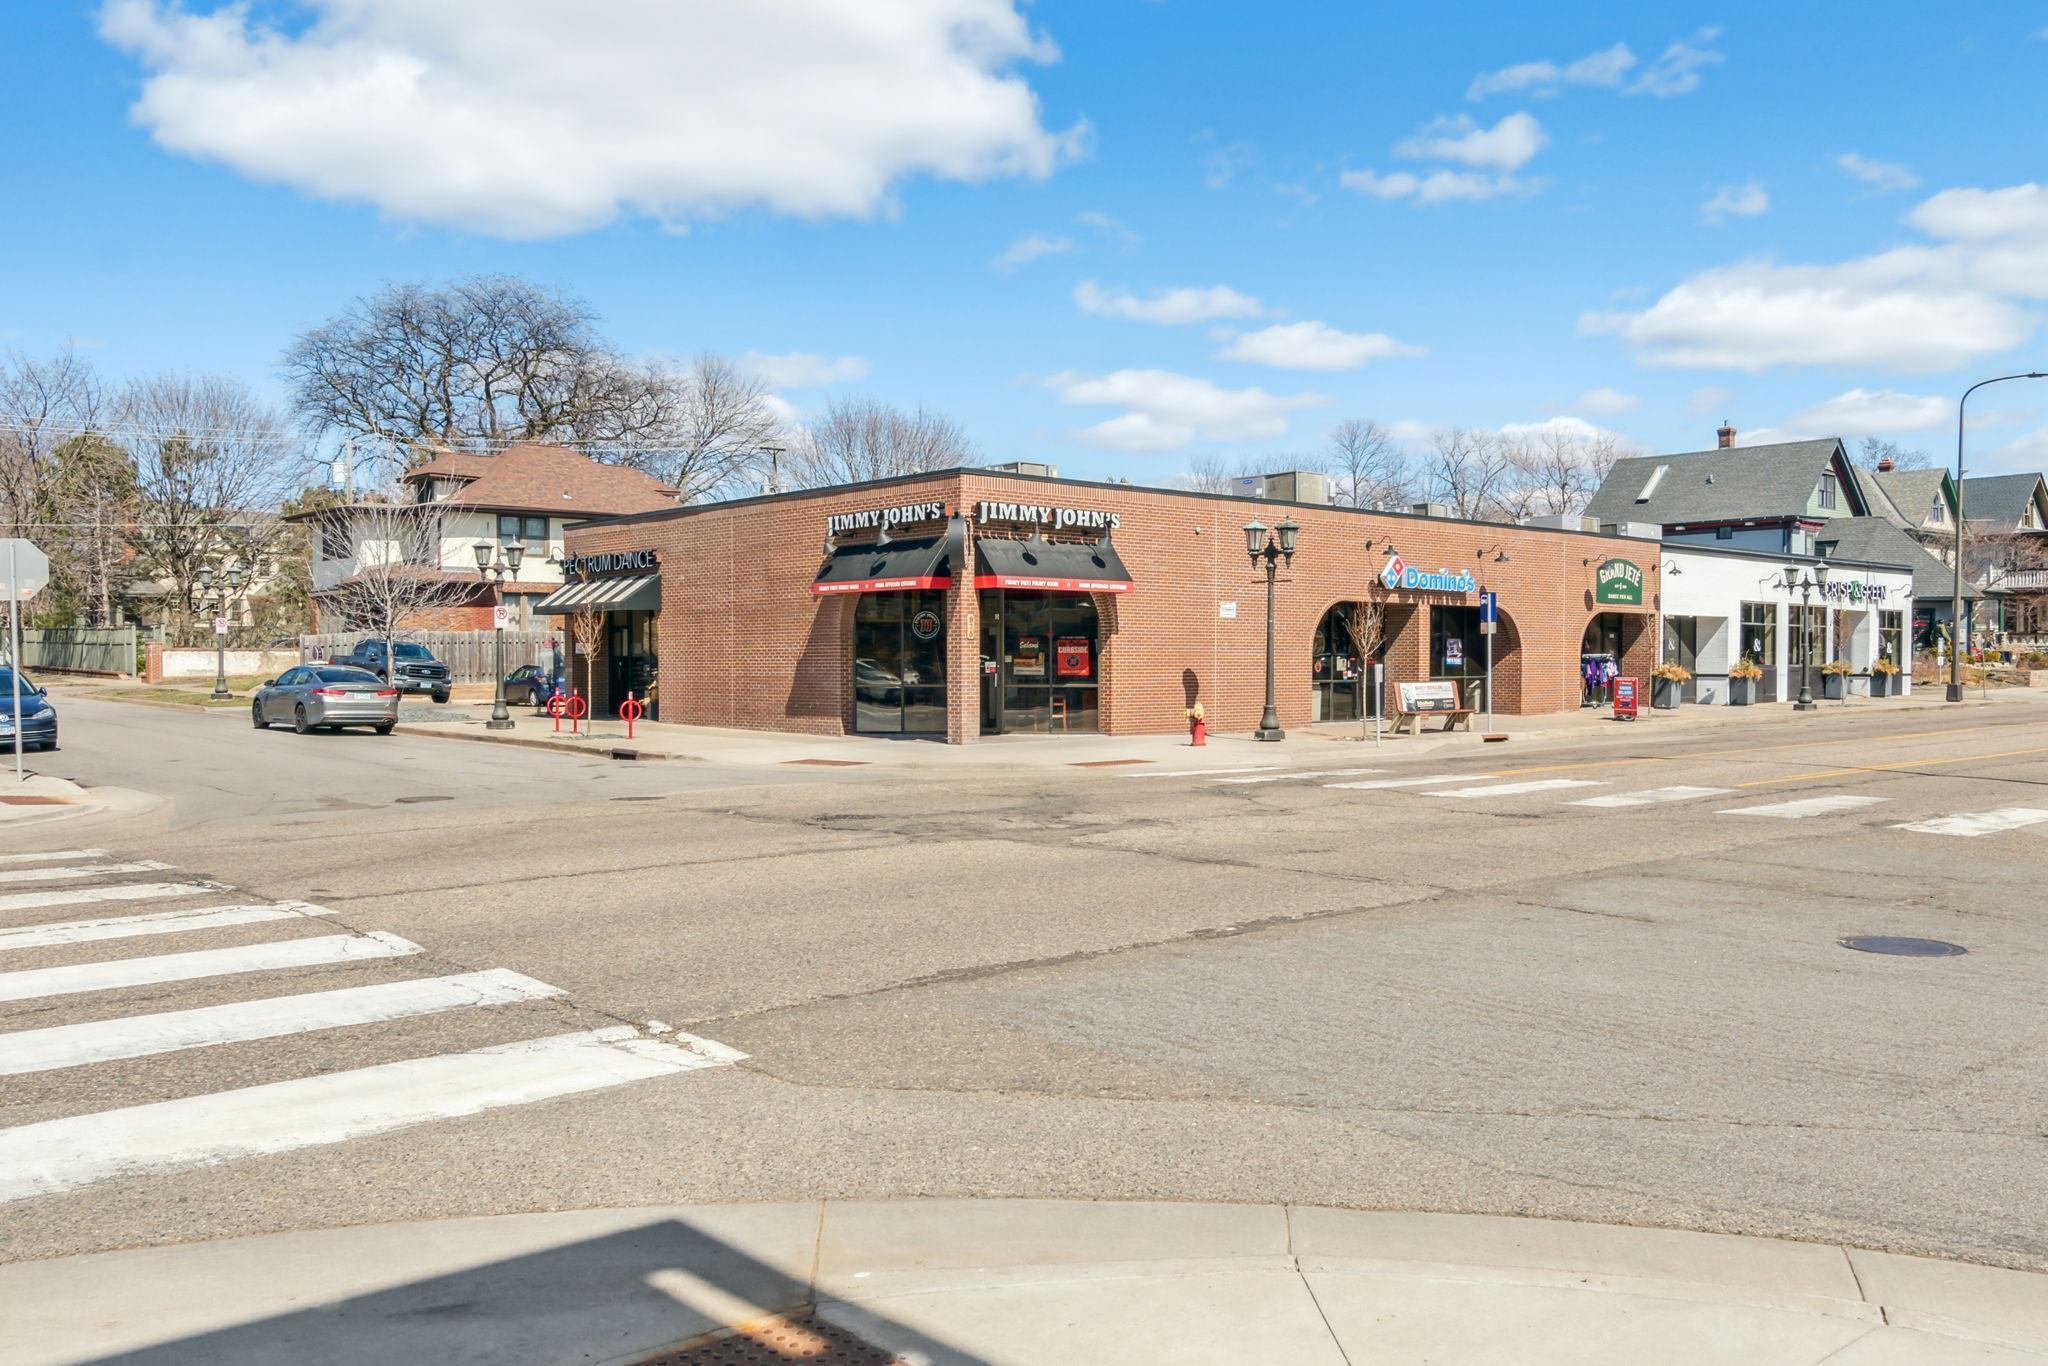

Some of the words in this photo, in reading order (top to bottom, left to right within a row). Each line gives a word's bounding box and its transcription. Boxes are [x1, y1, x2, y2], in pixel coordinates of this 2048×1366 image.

[827, 510, 880, 537] JIMMY
[882, 502, 941, 530] JOHN'S
[980, 501, 1051, 524] JIMMY
[1054, 508, 1121, 530] JOHN'S
[613, 550, 654, 571] DANCE
[1404, 566, 1475, 592] Domino's
[1600, 562, 1625, 584] GRAND
[1824, 581, 1853, 599] CRISP
[1861, 584, 1886, 600] GREEN
